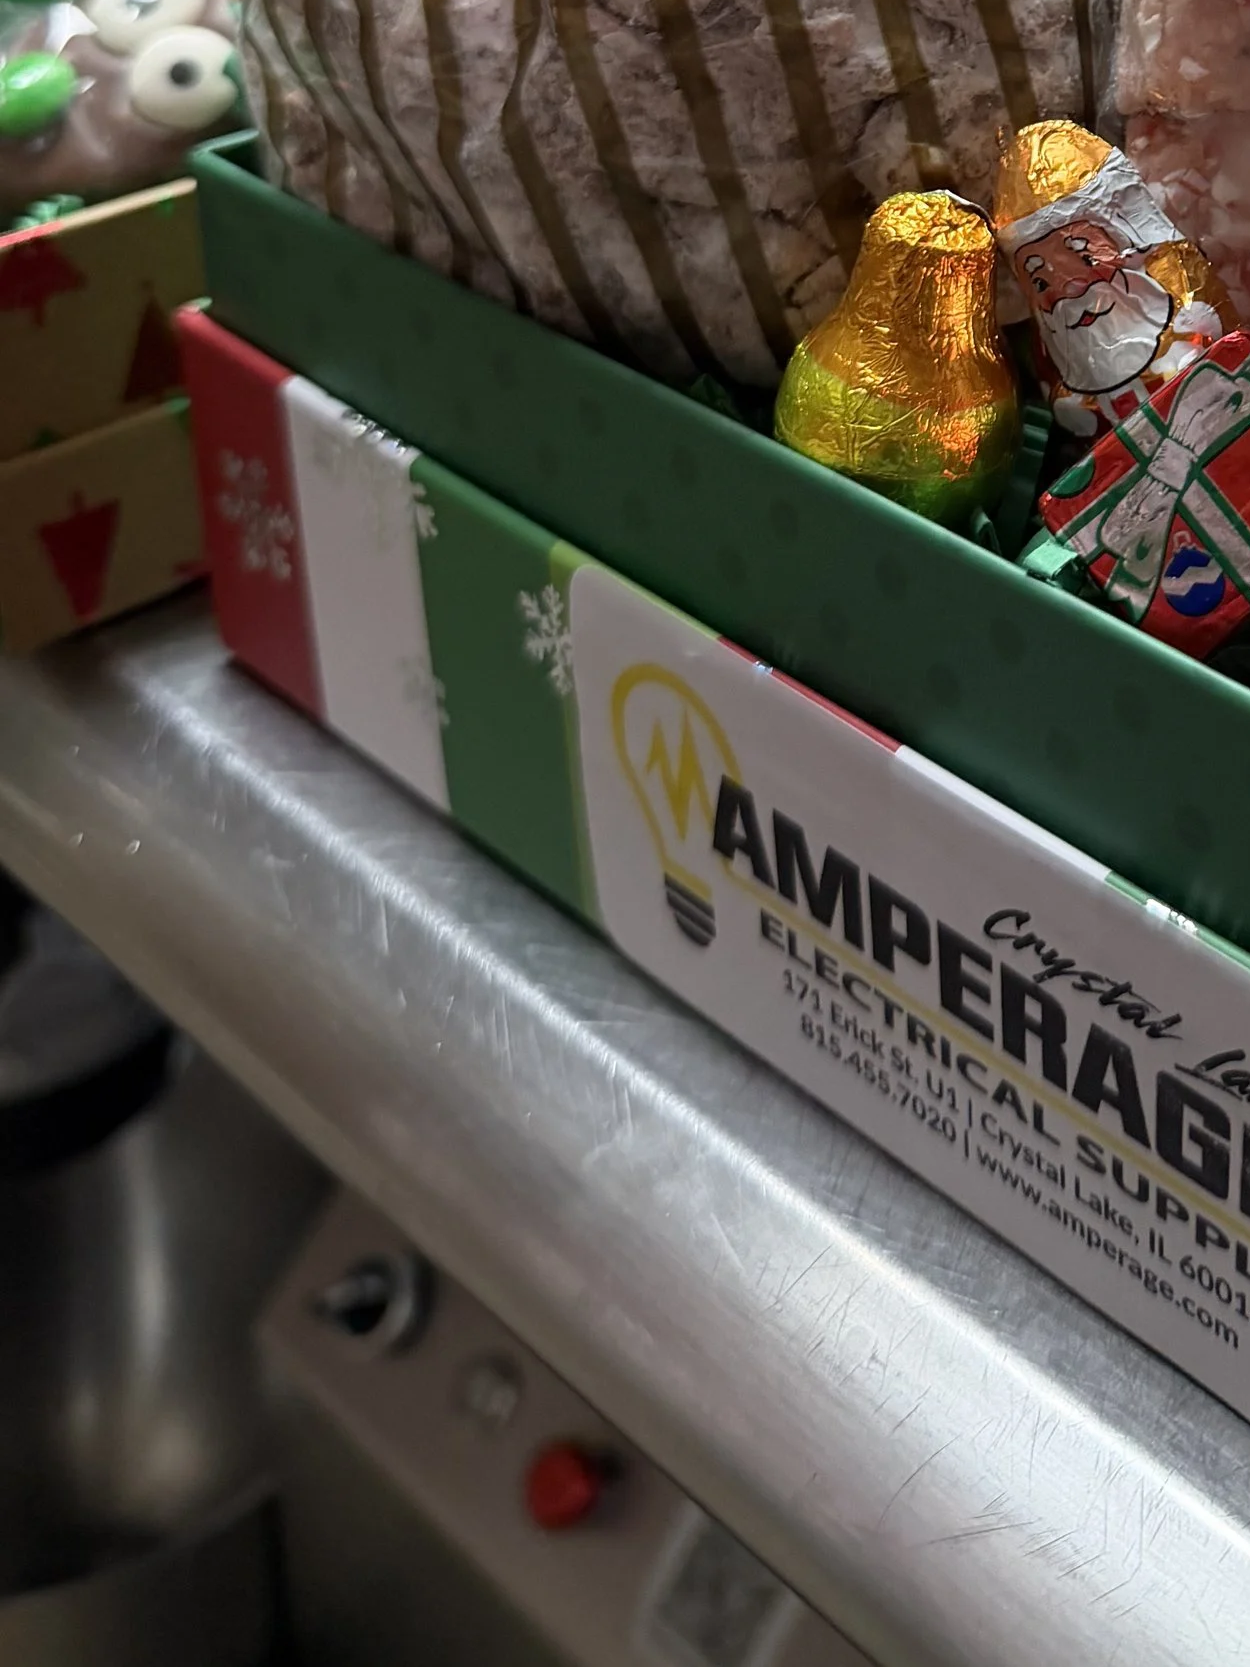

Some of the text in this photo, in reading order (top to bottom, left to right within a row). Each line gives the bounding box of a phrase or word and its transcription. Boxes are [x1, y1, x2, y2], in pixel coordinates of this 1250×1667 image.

[760, 907, 1061, 1147] ELECTRICAL
[983, 908, 1183, 1040] Crystal
[783, 968, 823, 1014] 171
[831, 1000, 884, 1060] Erick
[925, 1068, 960, 1113] U1
[980, 1112, 1066, 1189] Crystal
[1075, 1175, 1140, 1246] Lake,
[1149, 1228, 1173, 1265] IL
[800, 1013, 957, 1143] 815.455.7020
[976, 1144, 1240, 1350] www.amperage.com
